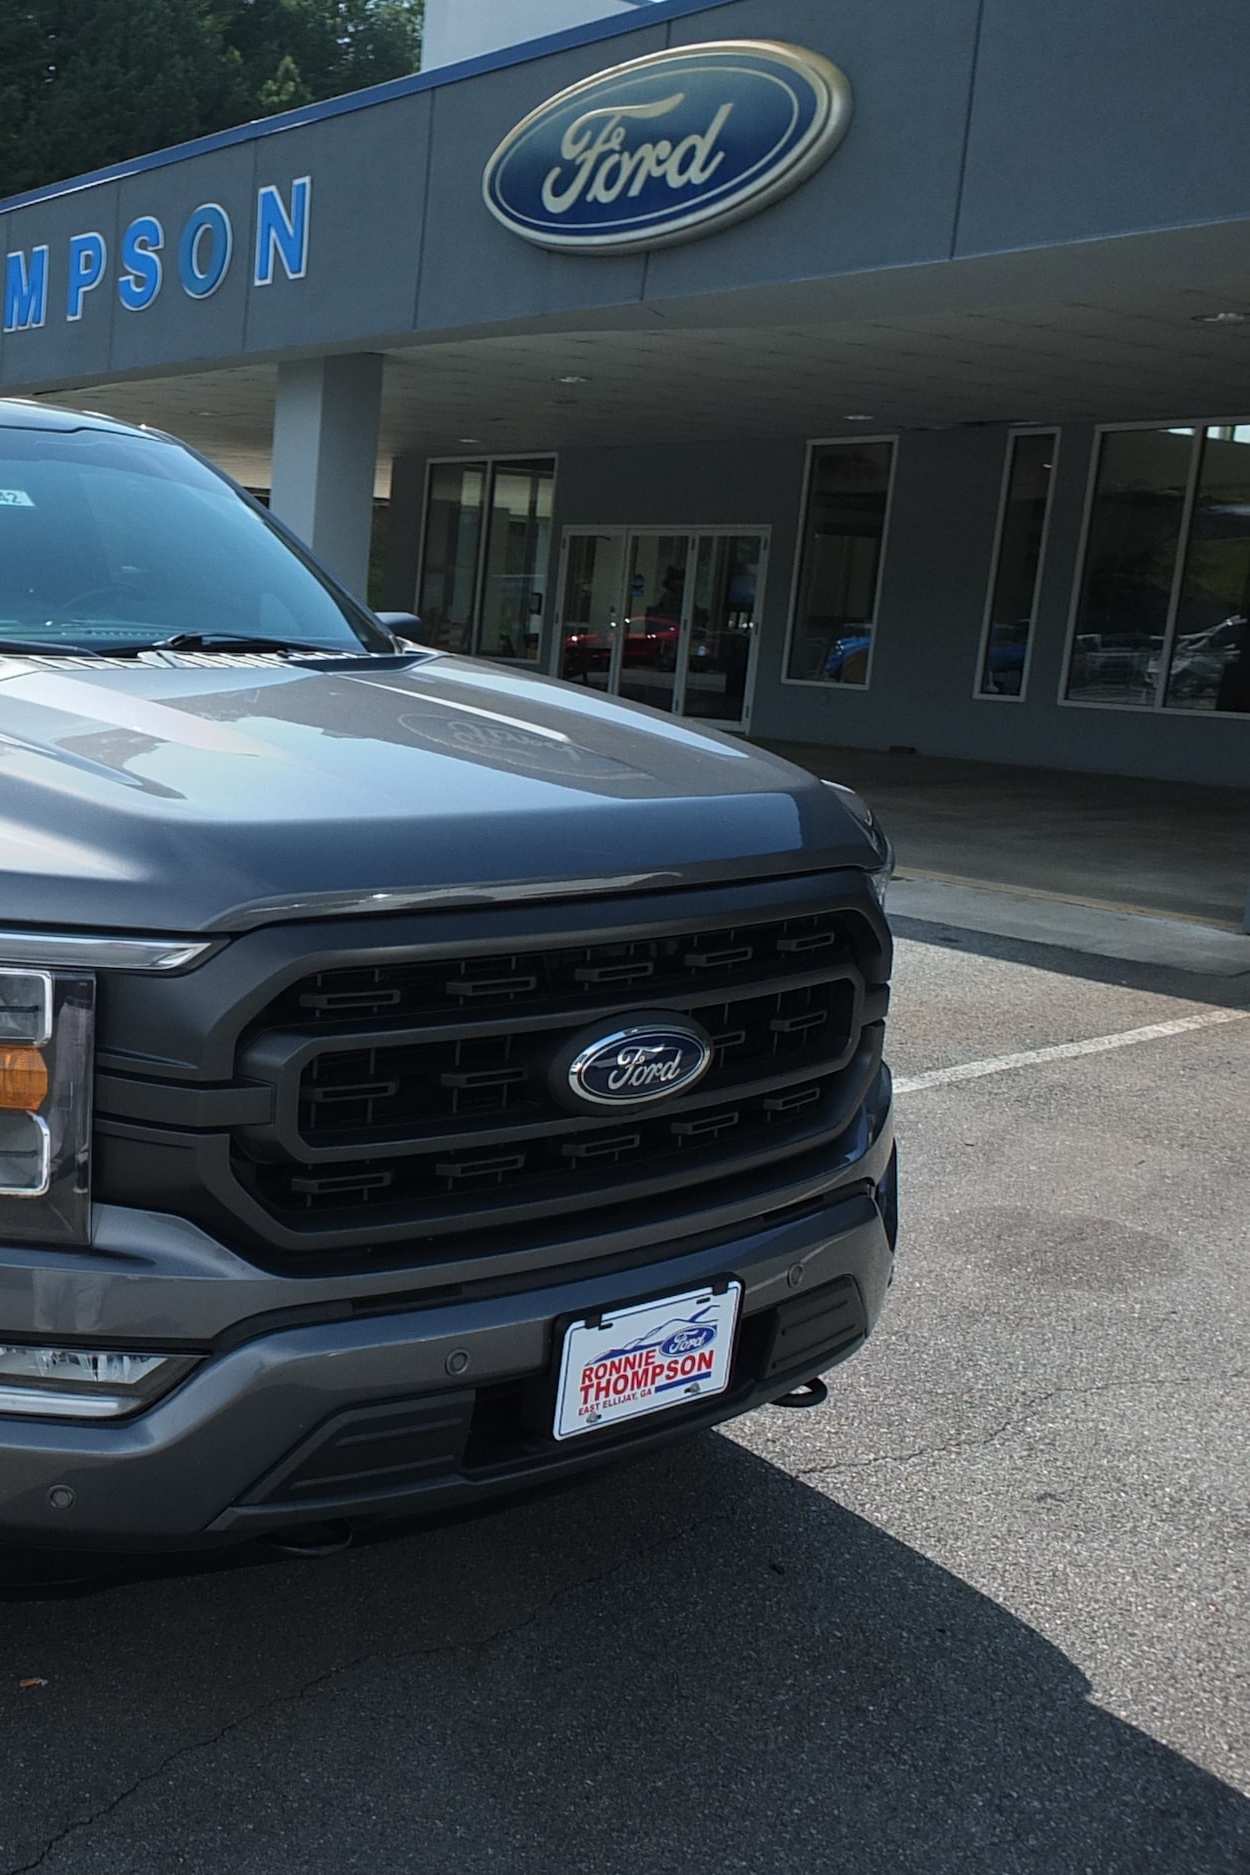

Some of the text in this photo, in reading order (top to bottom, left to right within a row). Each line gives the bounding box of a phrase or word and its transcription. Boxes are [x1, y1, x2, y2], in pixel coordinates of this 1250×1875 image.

[542, 93, 734, 214] Ford
[607, 1043, 684, 1090] Ford
[668, 1329, 708, 1354] Ford
[579, 1350, 715, 1406] THOMPSON
[581, 1349, 657, 1386] RONNIE
[578, 1402, 600, 1416] EAST
[639, 1388, 652, 1398] GA
